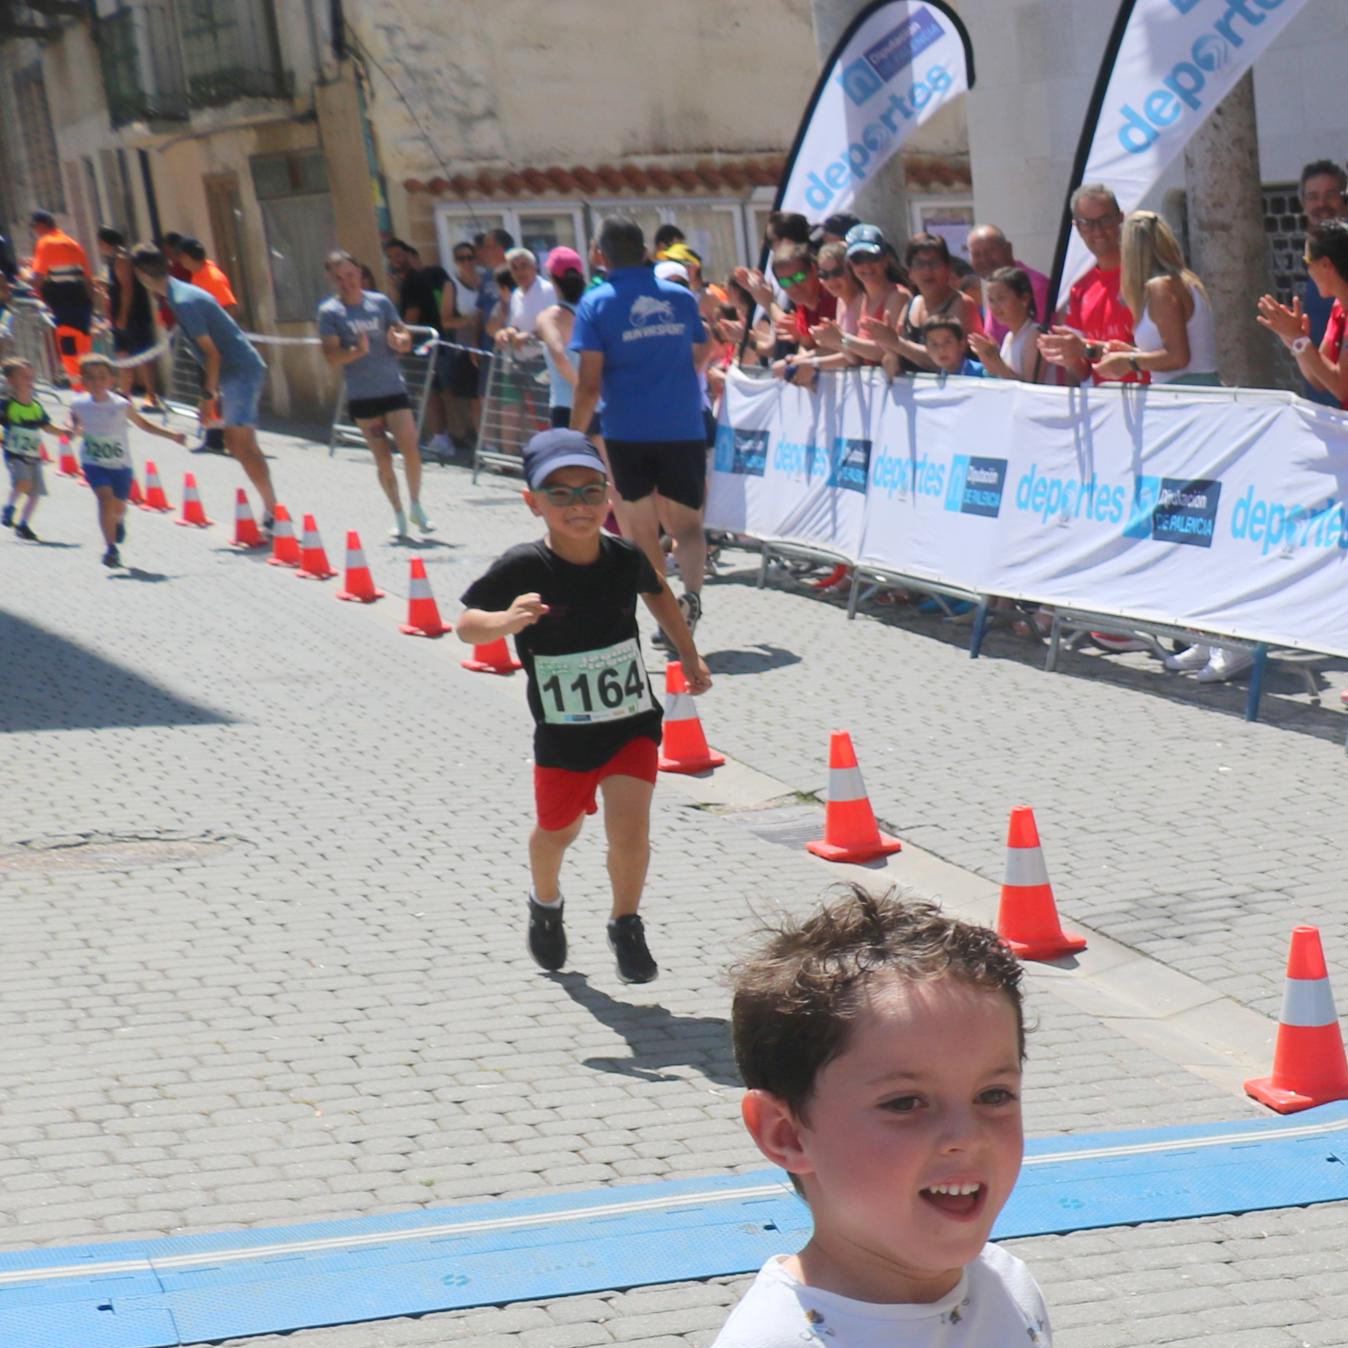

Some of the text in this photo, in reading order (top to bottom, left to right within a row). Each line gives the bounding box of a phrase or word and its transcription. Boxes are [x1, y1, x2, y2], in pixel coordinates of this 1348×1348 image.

[804, 65, 952, 211] deportes
[1016, 463, 1125, 525] deportes
[542, 659, 645, 713] 1164
